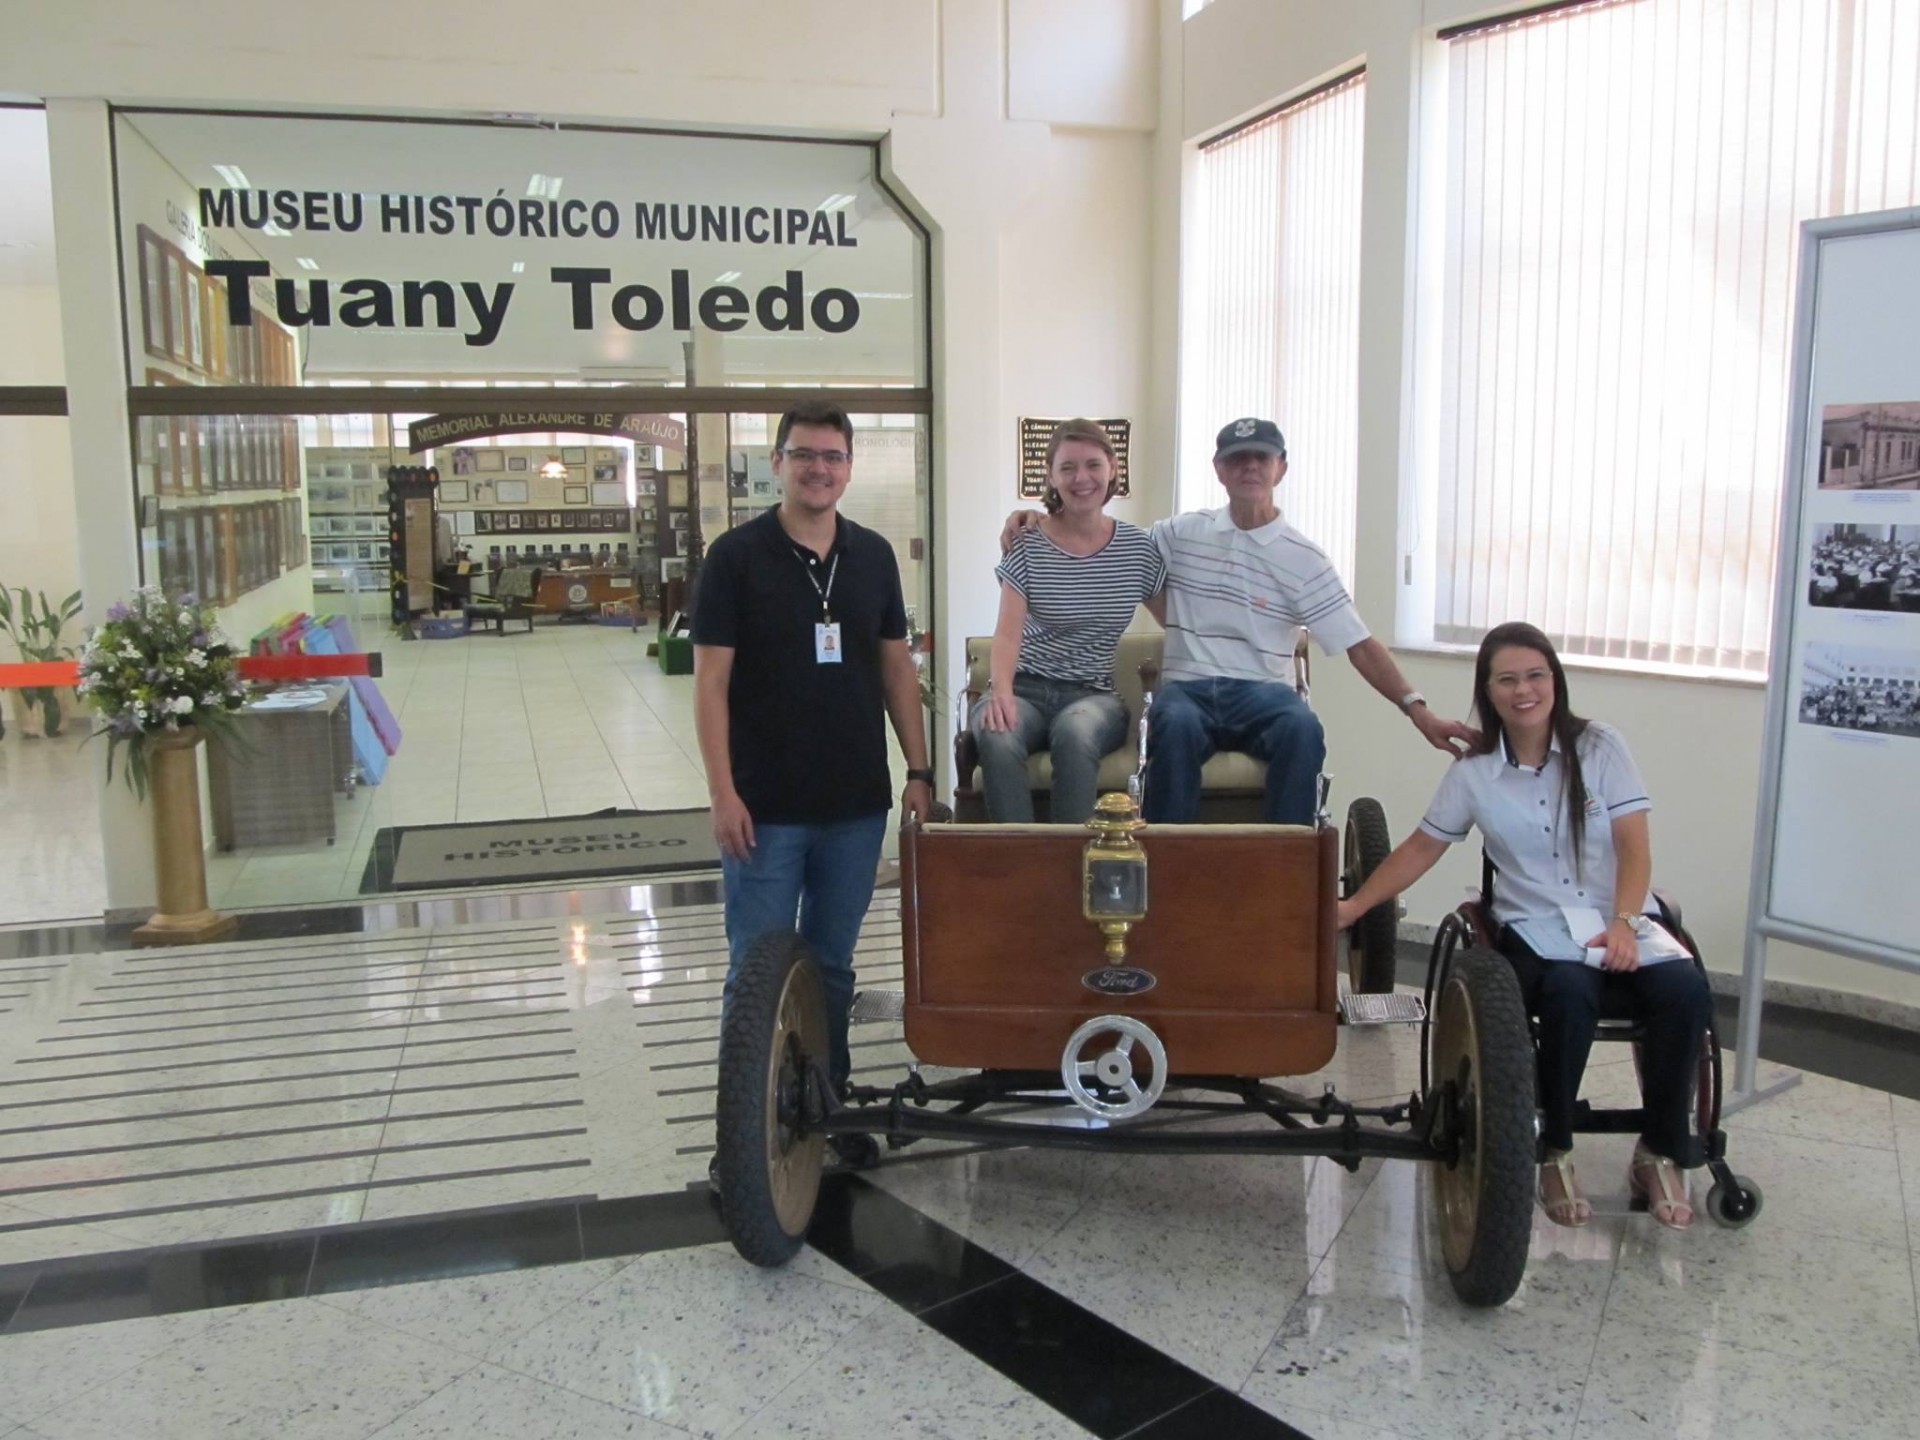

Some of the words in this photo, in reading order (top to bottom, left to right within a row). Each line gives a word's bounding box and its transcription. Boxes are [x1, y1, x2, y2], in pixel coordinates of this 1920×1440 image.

[199, 188, 362, 232] MUSEU
[381, 188, 619, 238] HISTÓRICO
[636, 203, 858, 247] MUNICIPAL
[203, 259, 515, 347] Tuany
[551, 267, 860, 334] Toledo
[416, 414, 493, 443] MEMORIAL
[499, 413, 586, 427] ALEXANDRE
[594, 414, 614, 428] DE
[620, 416, 679, 441] ARAÚJO
[488, 830, 642, 848] MUSEU
[1098, 970, 1139, 988] Ford
